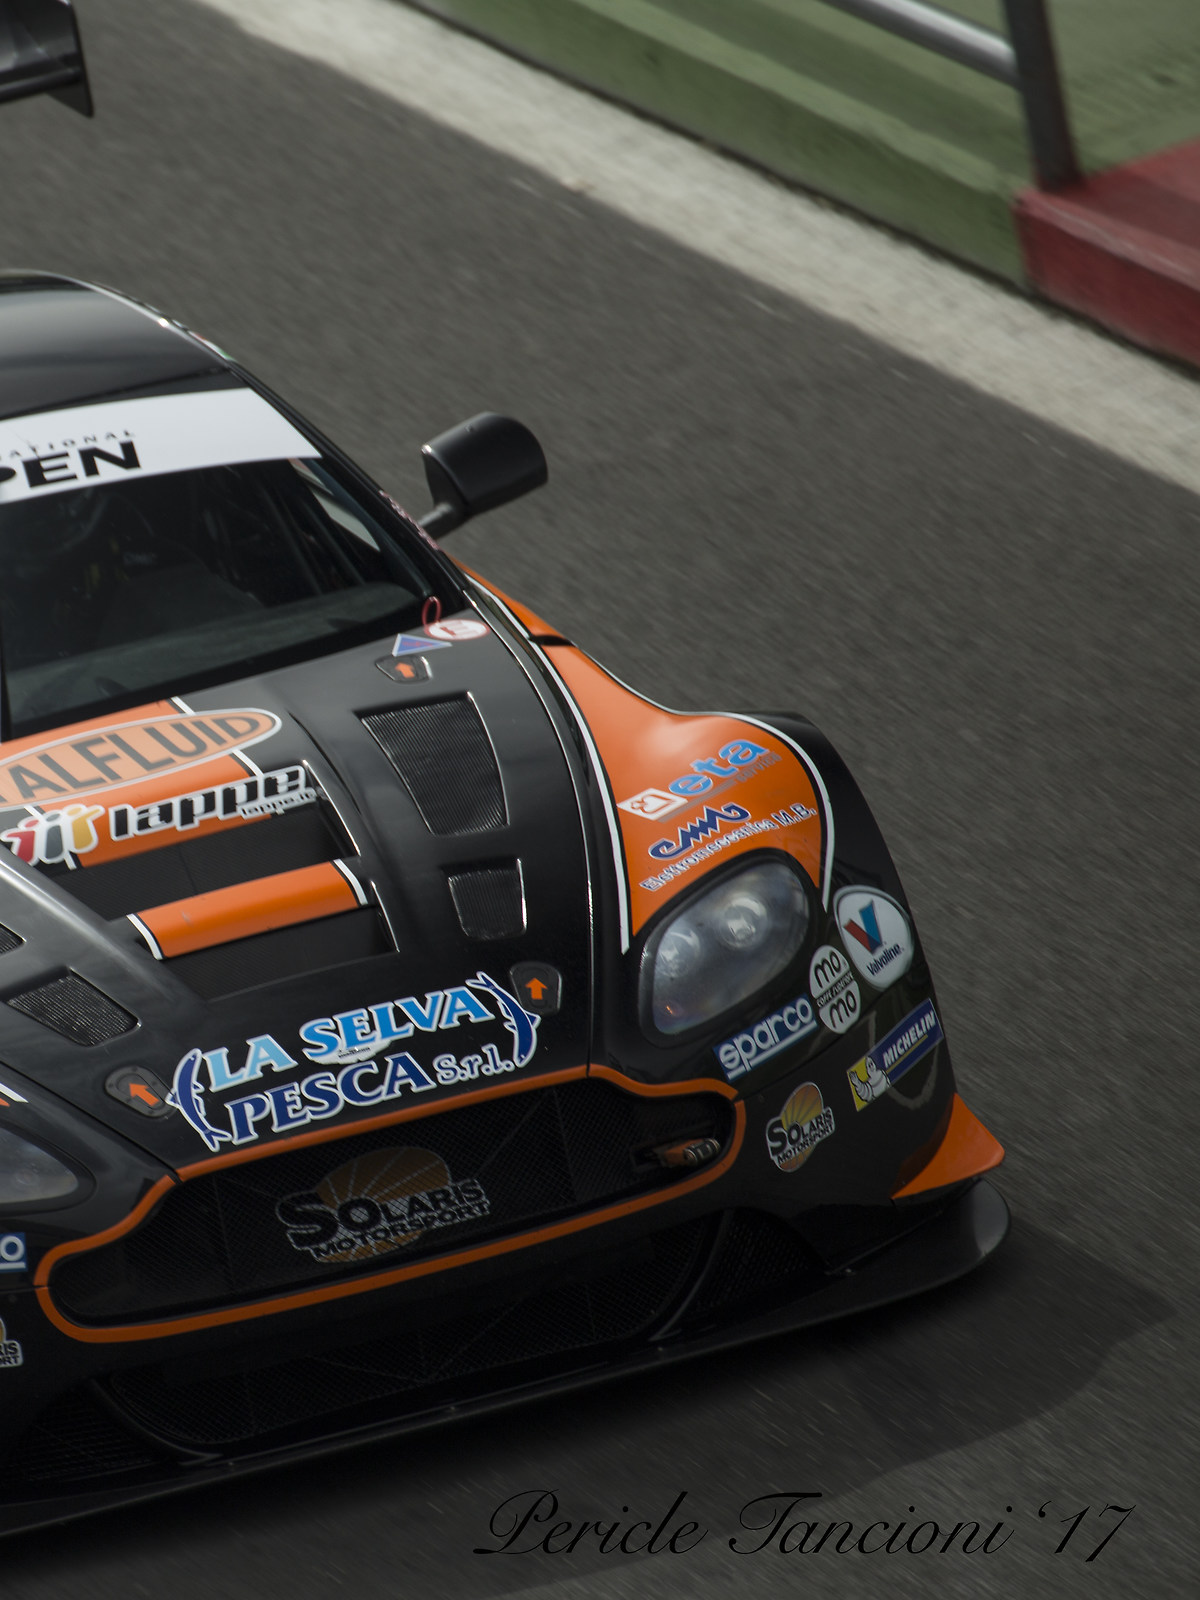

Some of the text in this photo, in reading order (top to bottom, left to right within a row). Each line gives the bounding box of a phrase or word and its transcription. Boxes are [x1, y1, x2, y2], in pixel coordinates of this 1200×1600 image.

[668, 739, 770, 796] eta
[770, 802, 818, 828] M.B.
[866, 942, 902, 977] Valvoline
[202, 985, 496, 1093] LA SELVA
[718, 997, 814, 1073] sparco
[882, 1009, 937, 1068] MICHELIN
[224, 1043, 516, 1145] PESCA S.r.l.
[312, 1200, 491, 1258] MOTORSPORT
